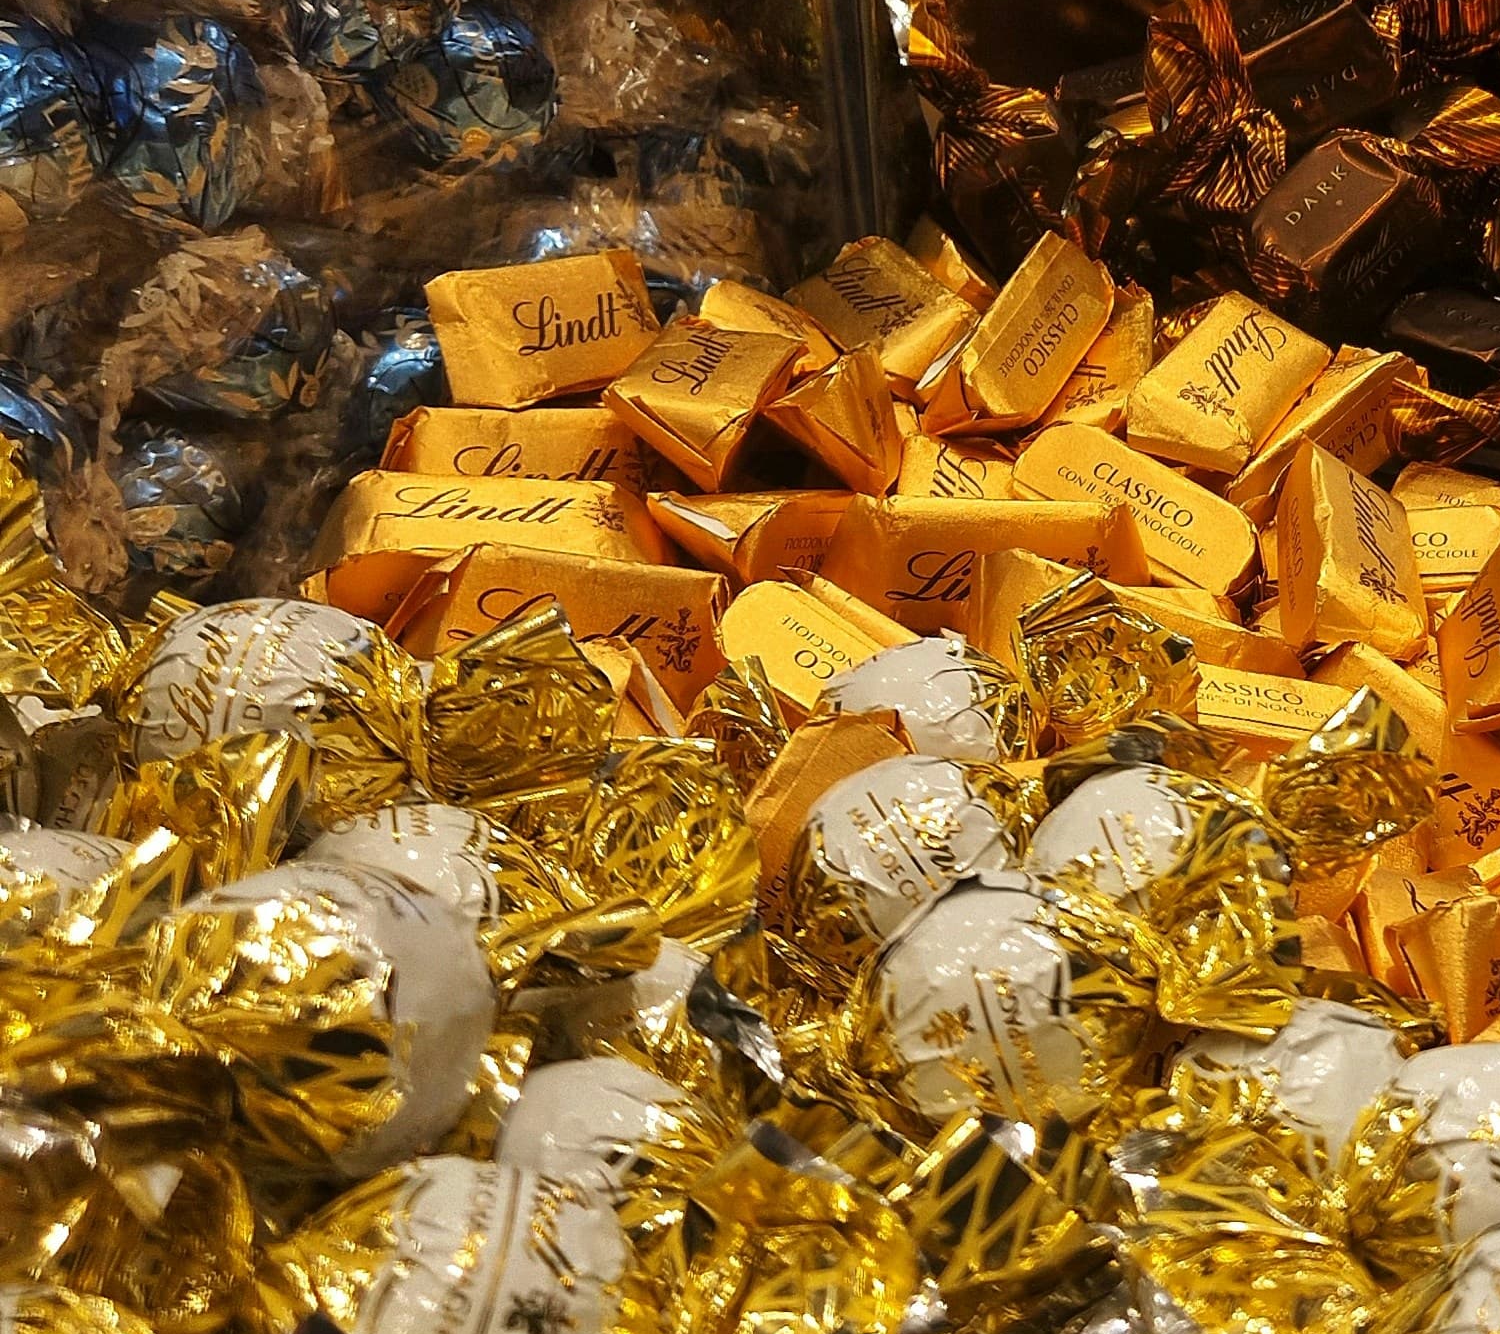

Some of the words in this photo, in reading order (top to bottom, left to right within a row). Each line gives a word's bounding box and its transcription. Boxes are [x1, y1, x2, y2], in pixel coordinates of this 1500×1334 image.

[1284, 165, 1348, 227] DARK
[822, 257, 900, 315] Lindt
[512, 290, 624, 357] Lindt
[1000, 330, 1036, 378] NOCCIOLE
[1022, 303, 1080, 377] CLASSICO
[1205, 309, 1287, 391] Lindt
[652, 327, 735, 398] Lindt
[372, 485, 583, 527] Lindt
[1056, 466, 1086, 490] CON
[1139, 515, 1207, 559] NOCCIOLE
[1092, 462, 1195, 529] CLASSICO
[1348, 468, 1396, 581] Lindt
[1414, 549, 1480, 560] OCCIOLE
[446, 587, 652, 651] Ldt
[163, 619, 237, 745] Lindt
[1204, 679, 1303, 706] ASSICO
[1250, 701, 1331, 723] NOCCIO
